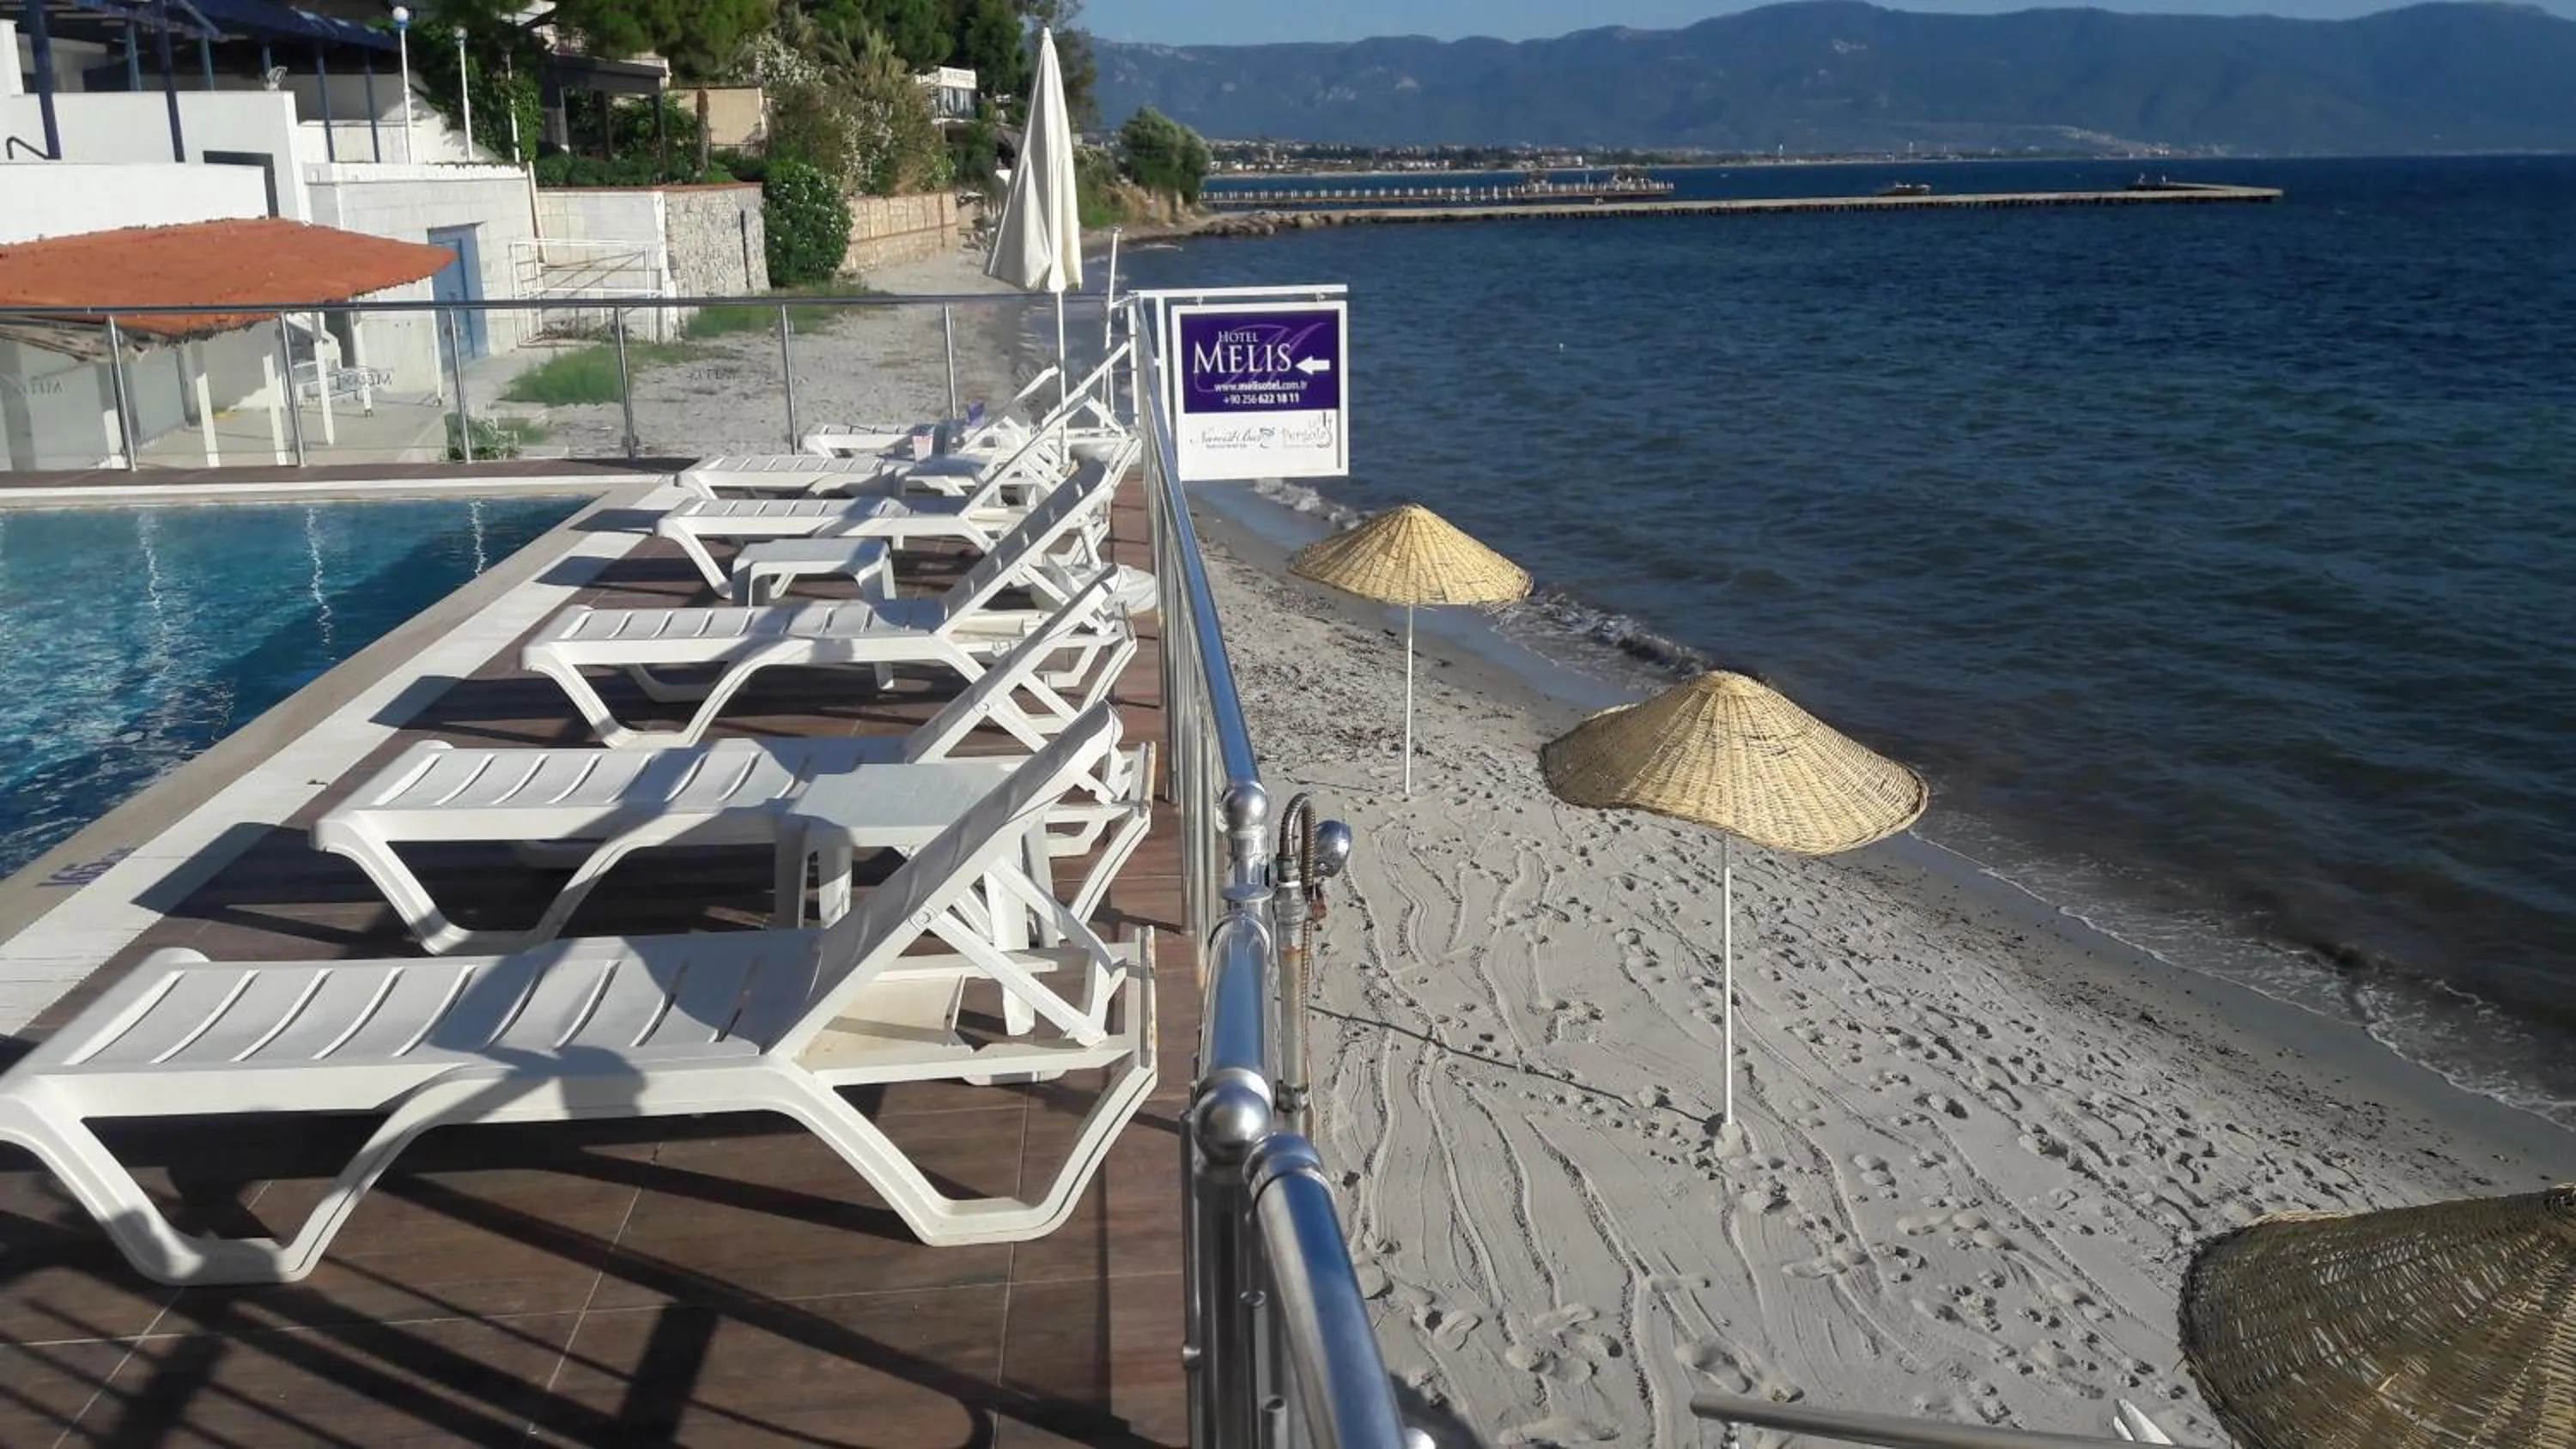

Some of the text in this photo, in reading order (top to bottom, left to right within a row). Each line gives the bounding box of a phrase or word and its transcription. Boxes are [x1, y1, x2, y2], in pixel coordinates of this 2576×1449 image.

[1218, 330, 1259, 343] HOTEL
[1194, 341, 1292, 373] MELIS
[1258, 393, 1275, 404] 622
